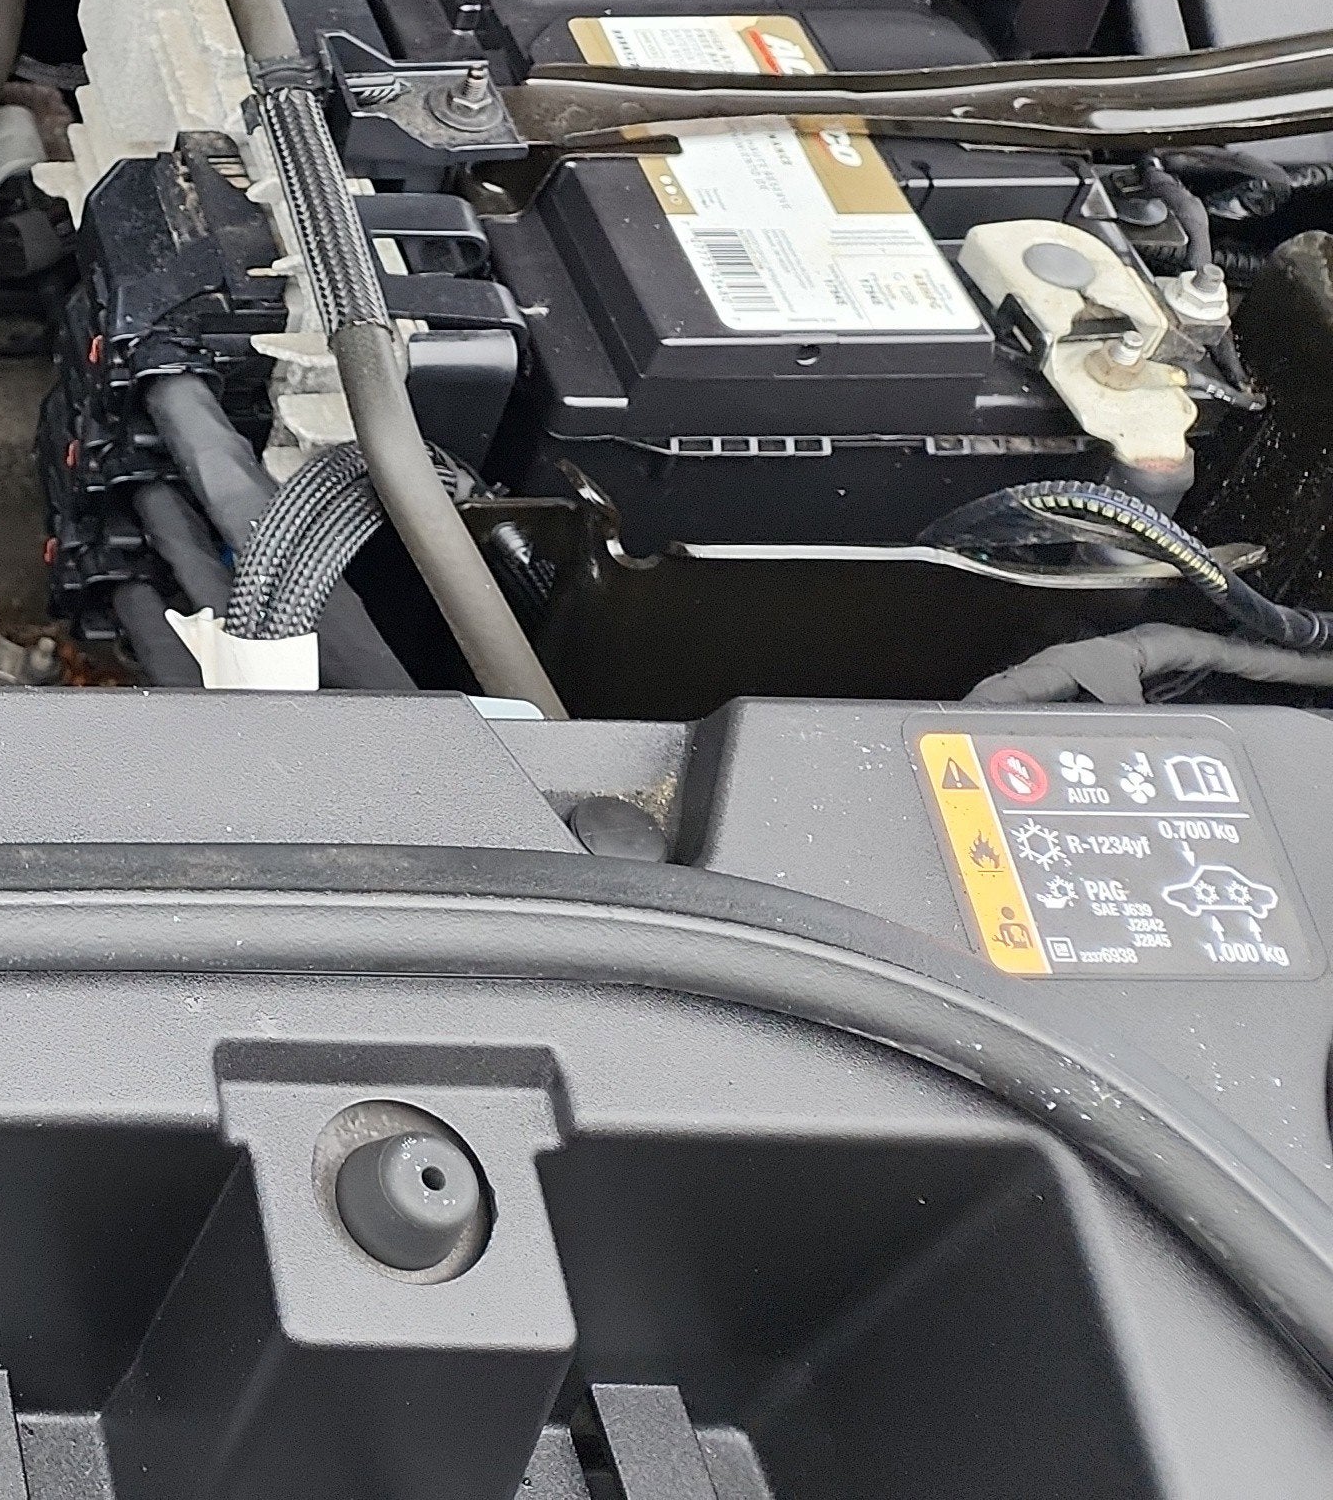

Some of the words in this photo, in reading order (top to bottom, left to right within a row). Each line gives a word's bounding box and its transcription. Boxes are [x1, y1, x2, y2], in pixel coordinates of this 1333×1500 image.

[1067, 787, 1110, 804] AUTO
[1157, 820, 1210, 840] 0.700
[1212, 821, 1241, 844] kg
[1066, 835, 1152, 857] R-1234yf
[1084, 880, 1128, 901] PAG
[1092, 902, 1121, 916] SAE
[1122, 902, 1153, 917] J639
[1203, 941, 1259, 963] 1.000
[1260, 943, 1291, 966] kg
